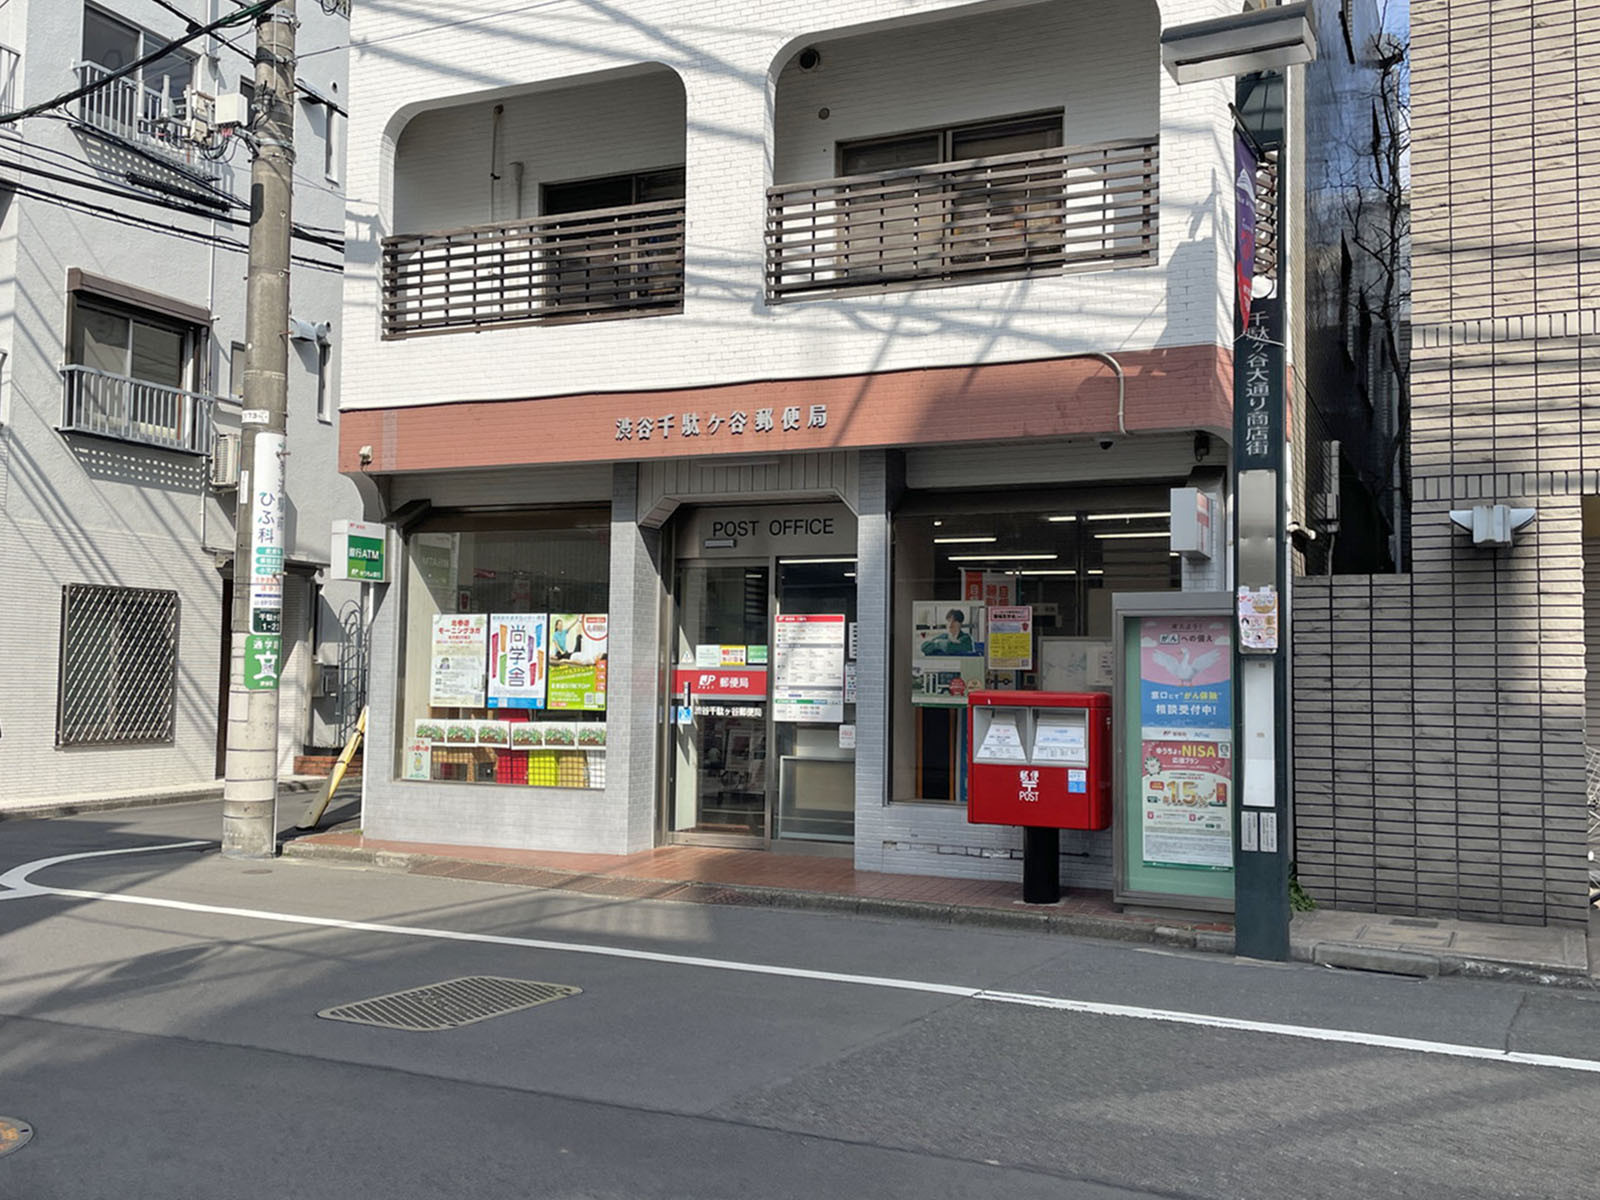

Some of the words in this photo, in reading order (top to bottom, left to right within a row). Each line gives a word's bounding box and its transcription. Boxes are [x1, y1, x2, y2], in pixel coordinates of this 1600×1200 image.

[258, 491, 275, 544] ひふ科
[712, 520, 760, 537] POST
[768, 518, 835, 536] OFFICE
[719, 676, 750, 689] 郵便局
[1156, 703, 1217, 716] 相談受付中!
[1181, 744, 1216, 758] NISA
[1019, 770, 1040, 783] 郵便
[1018, 791, 1040, 802] POST
